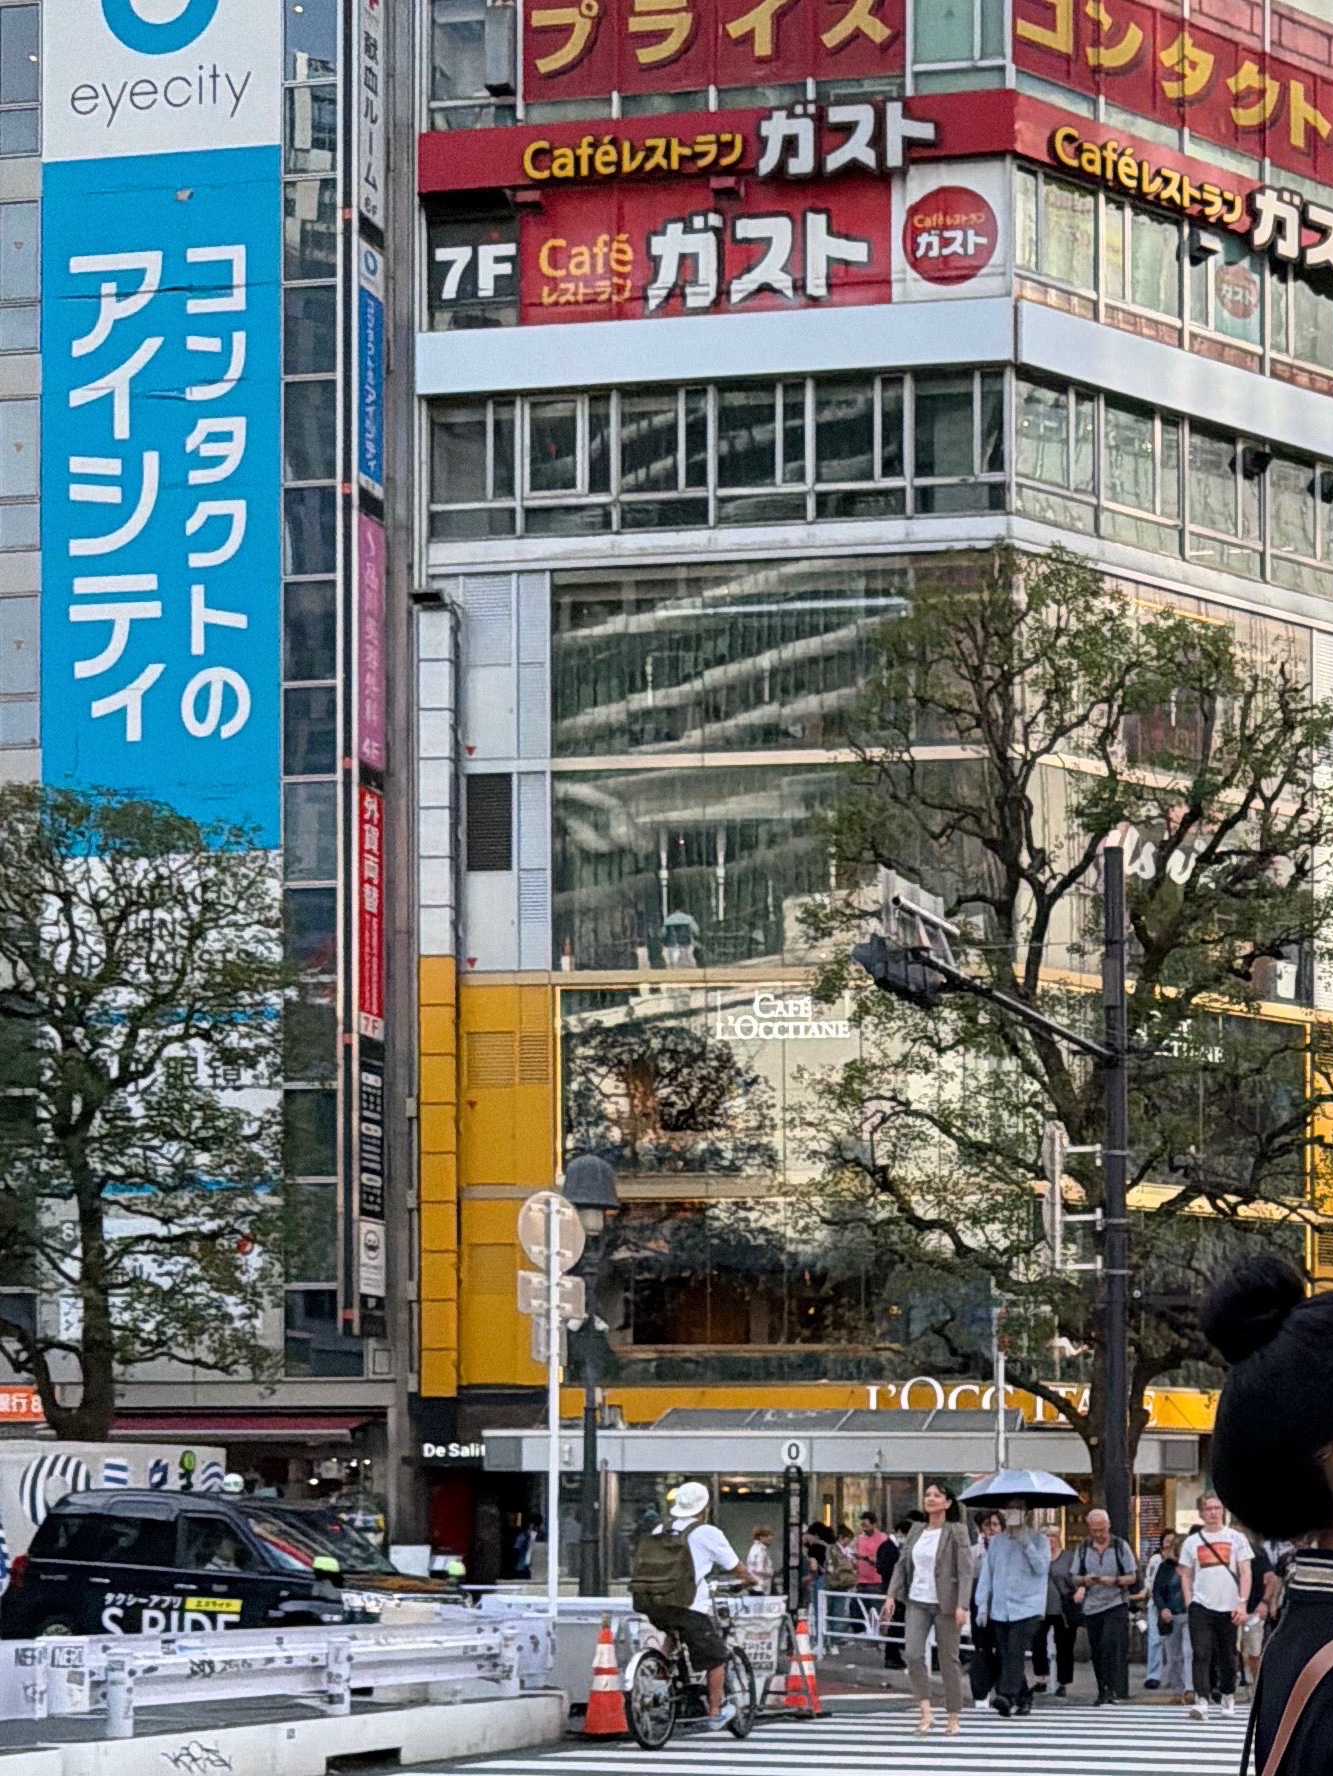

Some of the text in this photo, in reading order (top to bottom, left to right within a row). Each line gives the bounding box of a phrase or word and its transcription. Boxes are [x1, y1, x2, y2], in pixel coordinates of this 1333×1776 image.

[70, 64, 251, 127] eyecity
[757, 103, 937, 178] ガスト
[435, 243, 518, 300] 7F
[538, 236, 634, 277] Café
[646, 211, 869, 312] ガスト
[915, 229, 988, 258] ガスト
[541, 279, 632, 306] レストラン
[68, 250, 167, 742] アイシティ
[181, 244, 251, 740] コンタクトの
[423, 1443, 446, 1458] De
[105, 1593, 183, 1609] タクシーアプリ
